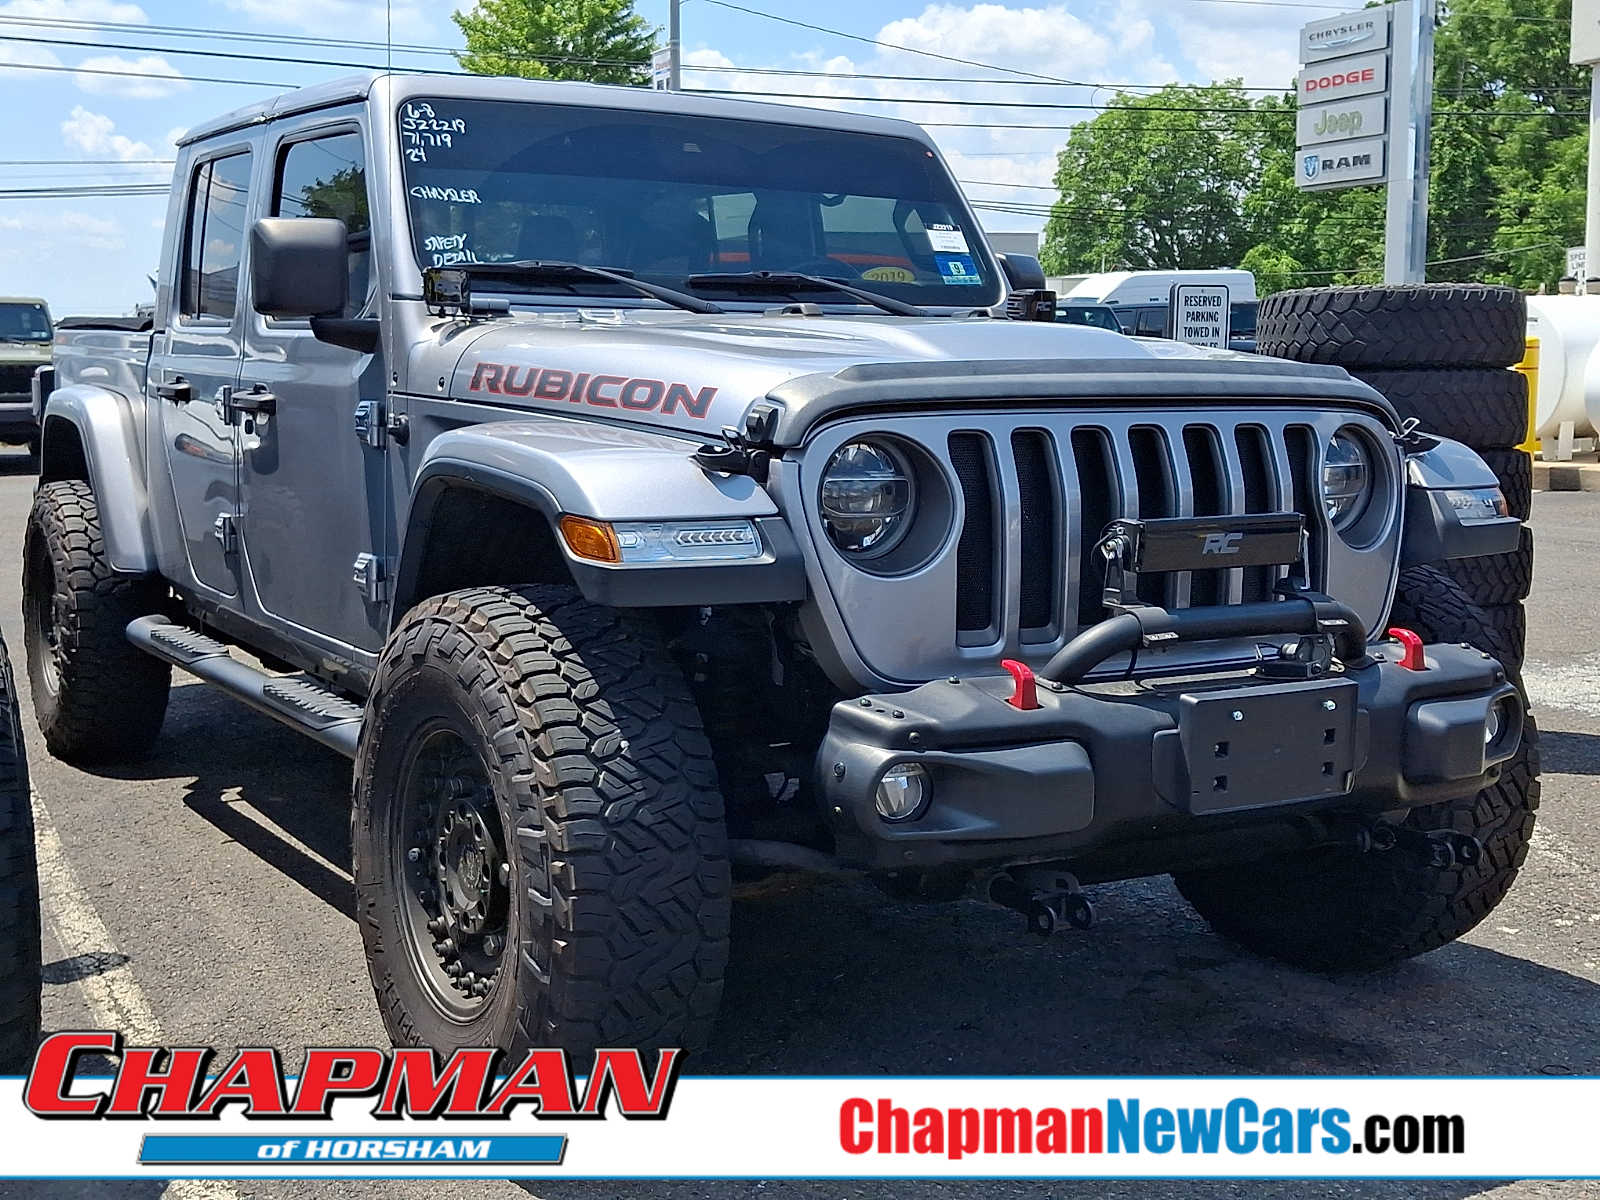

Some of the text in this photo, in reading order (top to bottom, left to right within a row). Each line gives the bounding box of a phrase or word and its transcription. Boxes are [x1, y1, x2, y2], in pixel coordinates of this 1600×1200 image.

[1308, 21, 1374, 41] CHRYSLER
[1305, 68, 1375, 92] DODGE
[1314, 109, 1363, 136] Jeep
[1321, 153, 1371, 171] RAM
[1184, 295, 1222, 307] RESERVED
[1186, 311, 1219, 322] PARKING
[1184, 326, 1220, 338] TOWED IN
[470, 362, 719, 419] RUBICON
